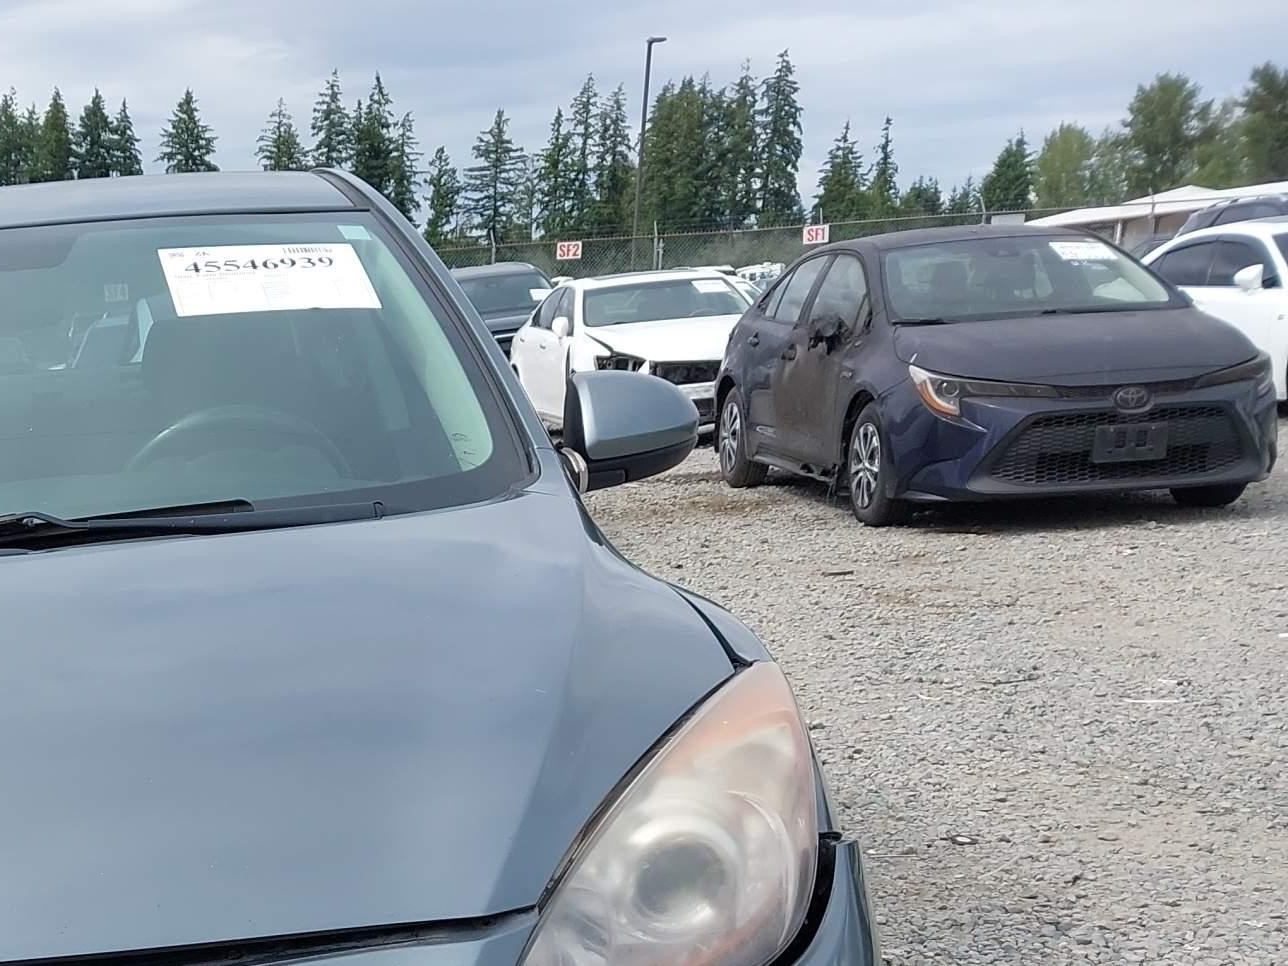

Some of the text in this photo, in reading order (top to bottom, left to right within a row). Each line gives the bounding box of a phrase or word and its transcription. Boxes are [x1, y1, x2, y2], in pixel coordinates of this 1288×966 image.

[807, 227, 825, 241] SF1
[559, 243, 580, 257] SF2
[185, 256, 333, 273] 45546939
